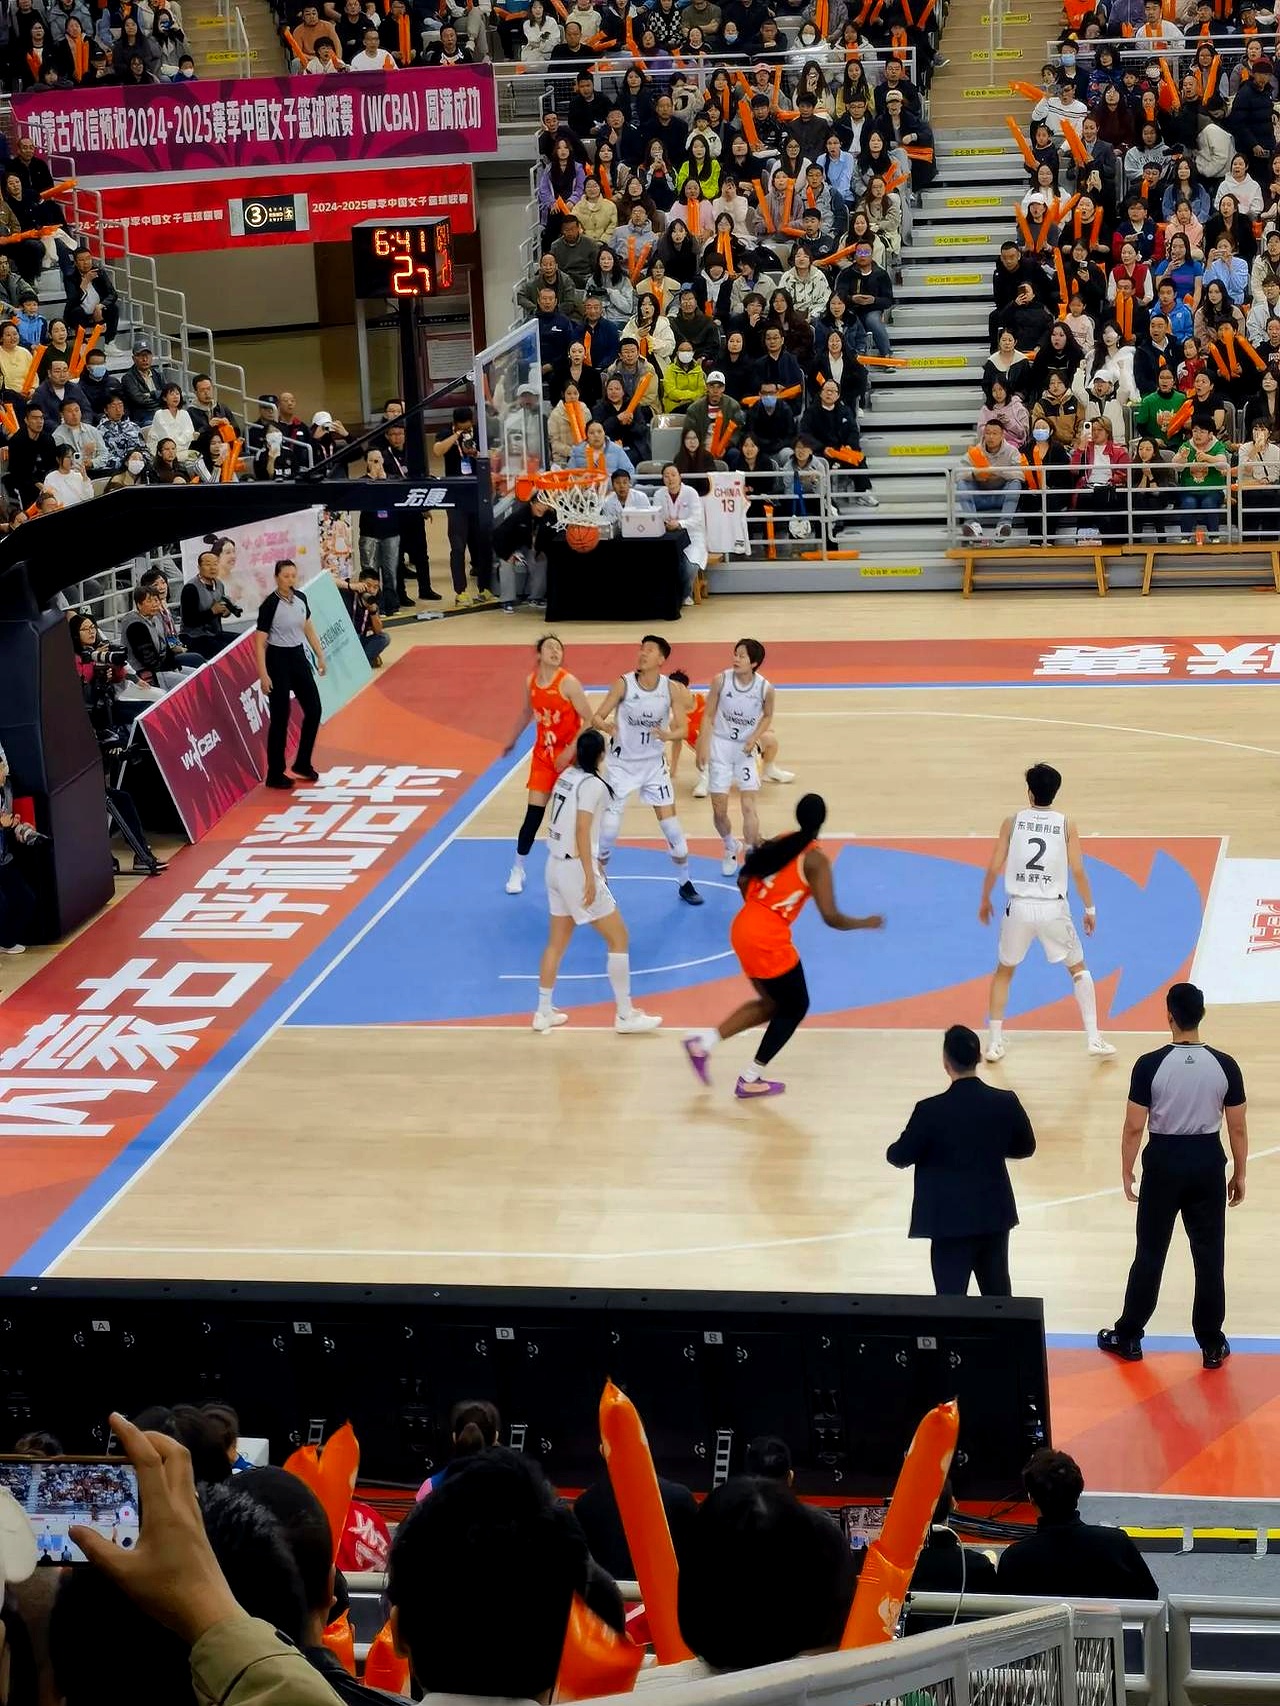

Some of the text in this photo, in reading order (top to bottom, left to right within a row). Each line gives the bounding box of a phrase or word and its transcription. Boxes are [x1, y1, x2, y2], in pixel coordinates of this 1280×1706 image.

[251, 206, 261, 223] 3
[374, 230, 426, 256] 6:41
[714, 487, 741, 498] CHINA
[721, 499, 735, 512] 13
[640, 731, 650, 744] 11
[730, 727, 740, 740] 3
[743, 767, 751, 781] 3
[658, 785, 670, 799] 11
[1026, 837, 1047, 871] 2
